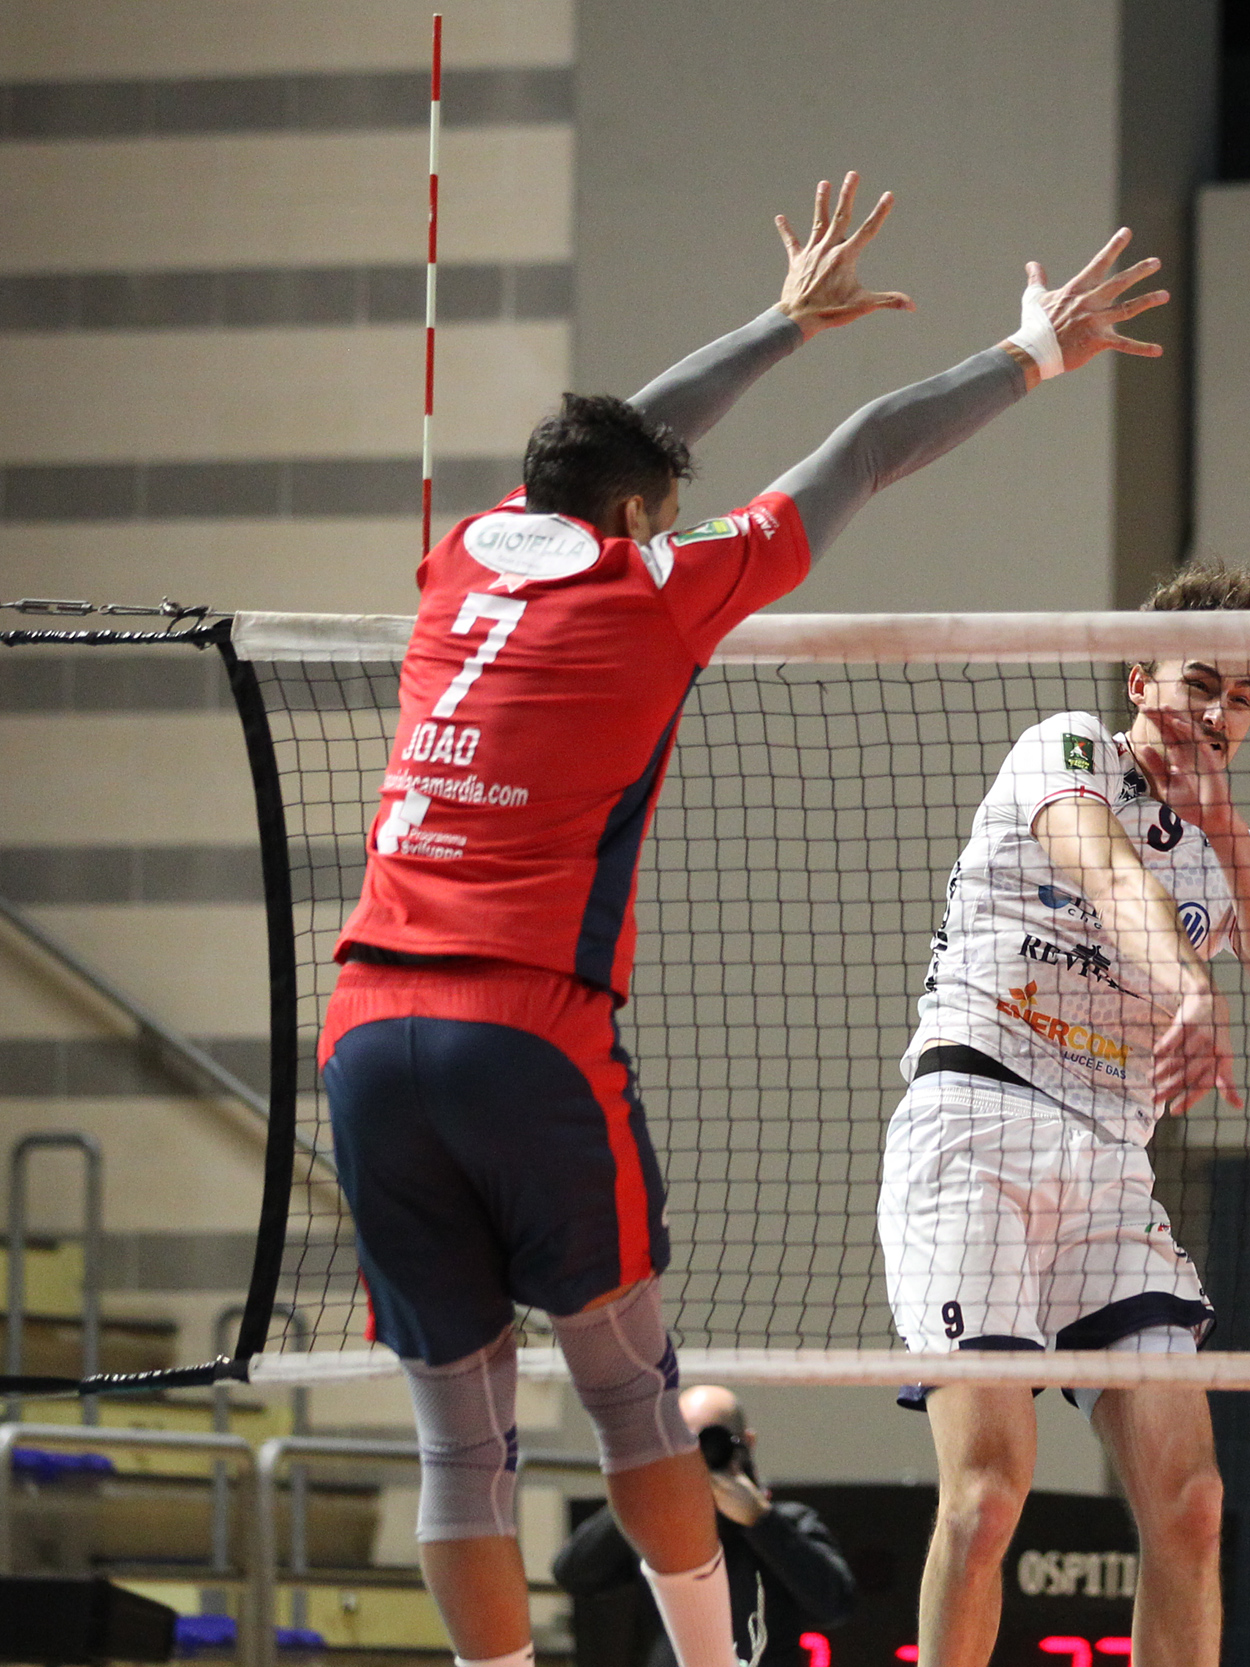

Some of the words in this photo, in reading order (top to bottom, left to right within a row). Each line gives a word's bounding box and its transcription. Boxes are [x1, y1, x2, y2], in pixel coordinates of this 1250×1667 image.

[476, 521, 586, 557] GIOIELLA
[432, 592, 528, 719] 7
[401, 722, 481, 766] JOAO
[1147, 803, 1184, 852] 9
[996, 998, 1129, 1067] ENERCOM
[1063, 1051, 1094, 1069] LUCE
[1095, 1061, 1104, 1072] E
[1105, 1064, 1127, 1080] GAS
[941, 1300, 965, 1339] 9
